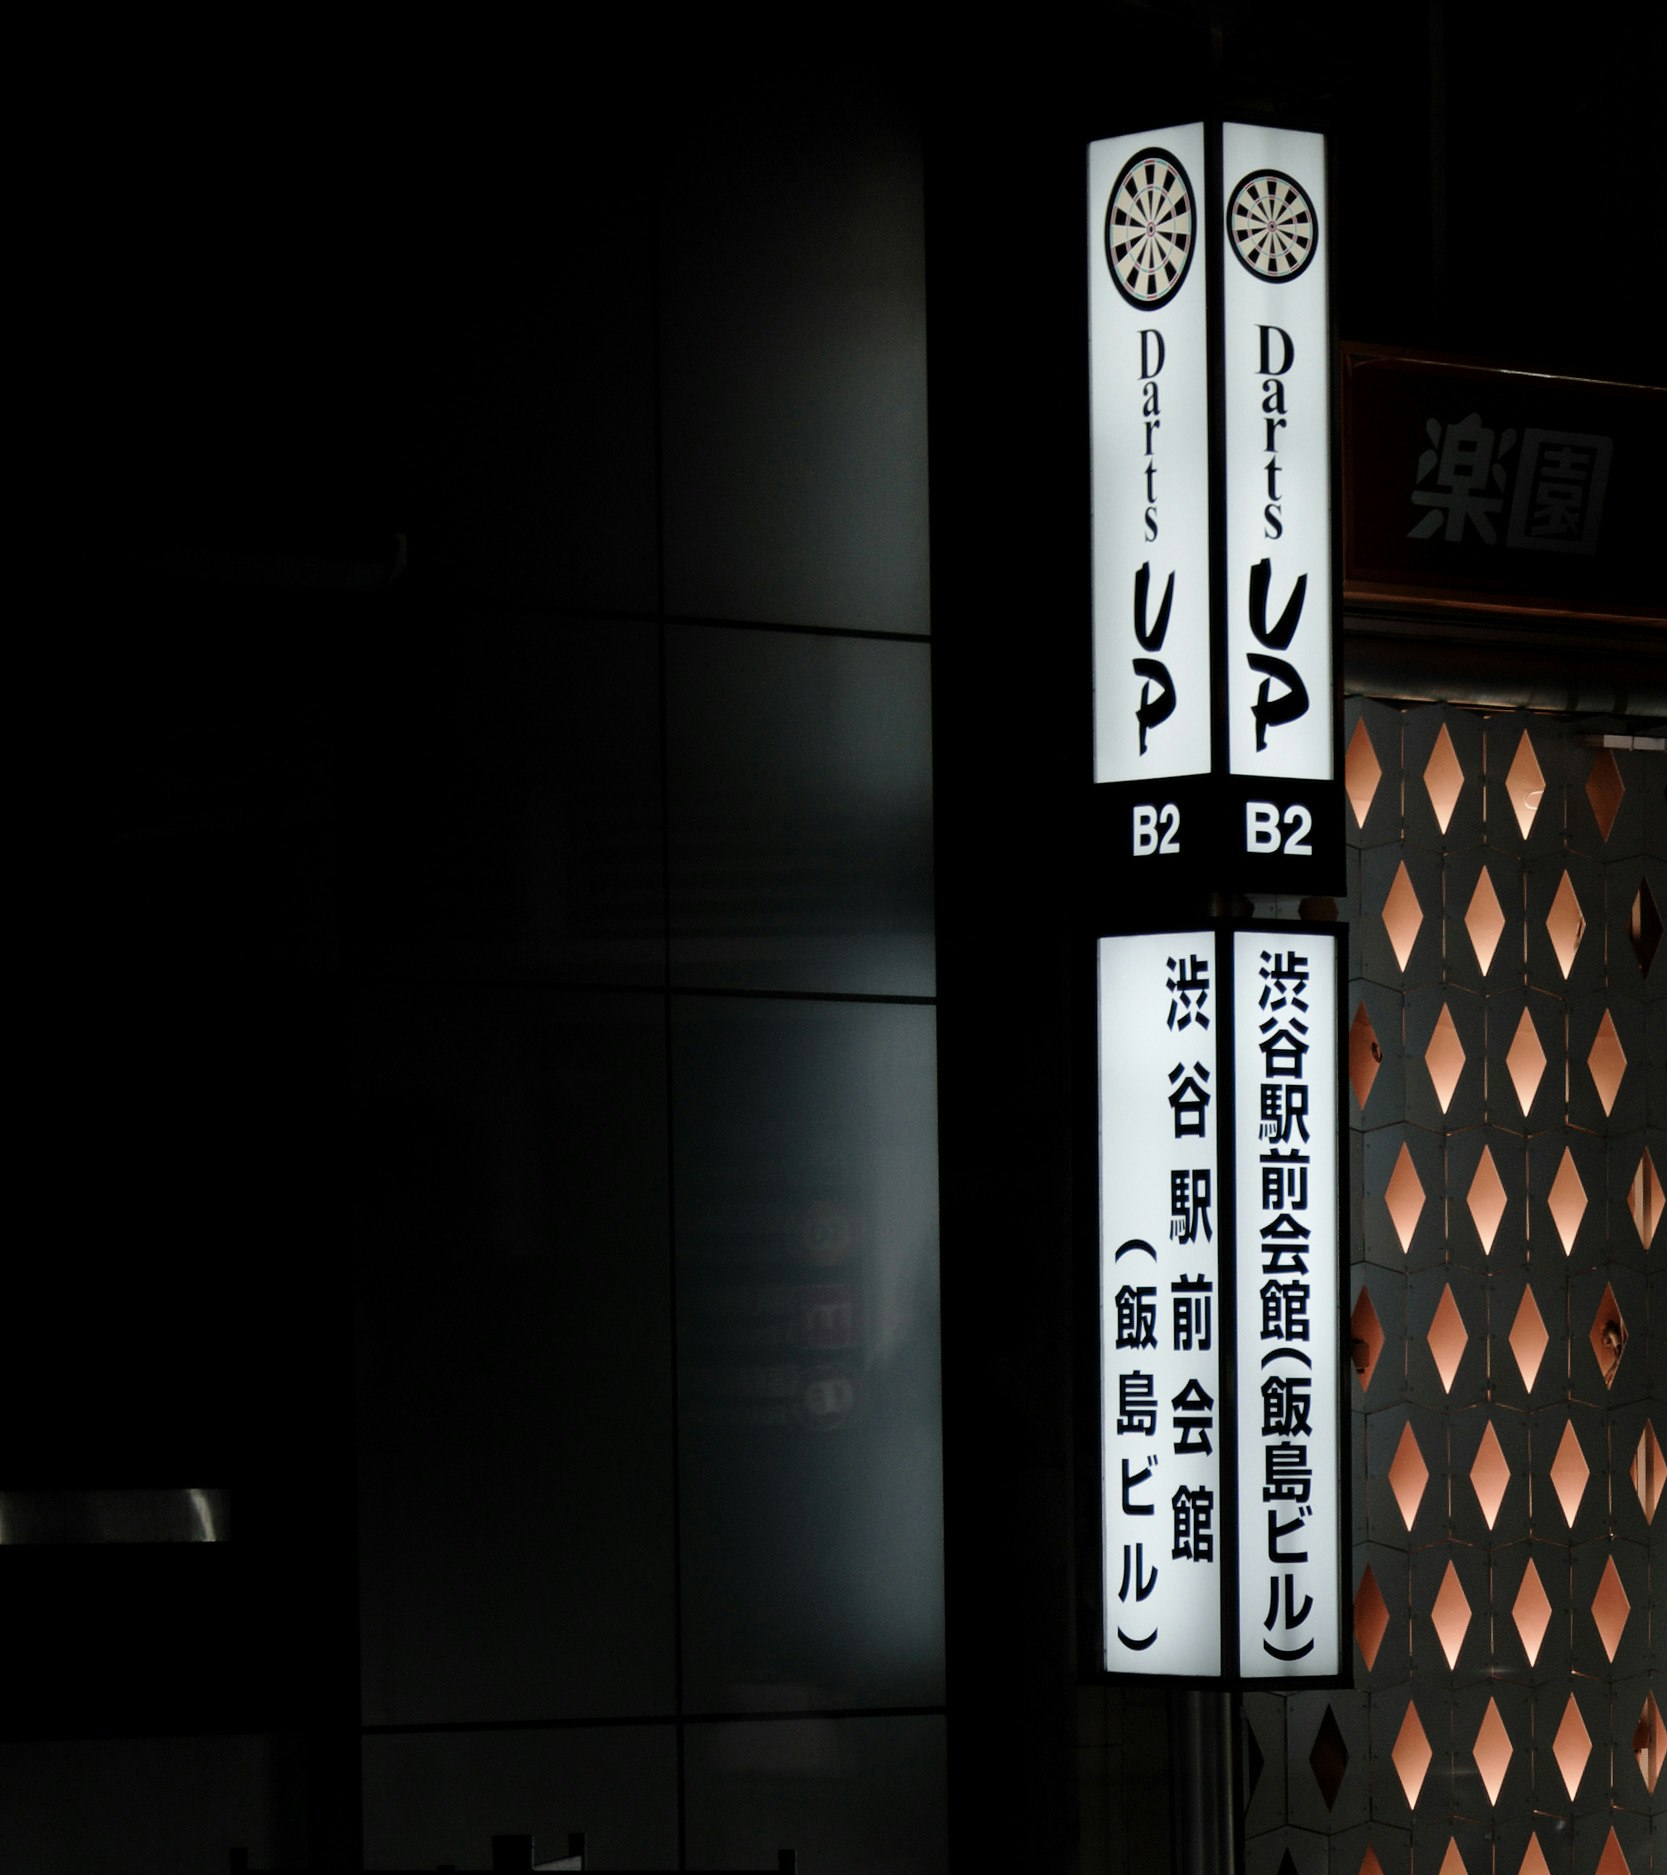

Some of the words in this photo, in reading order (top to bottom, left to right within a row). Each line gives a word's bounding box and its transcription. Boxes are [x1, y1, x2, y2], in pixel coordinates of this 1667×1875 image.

[1138, 328, 1165, 543] Darts
[1253, 324, 1295, 541] Darts
[1406, 410, 1615, 559] 楽園
[1132, 559, 1177, 756] UP
[1246, 557, 1310, 753] UP
[1131, 803, 1182, 857] B2
[1244, 801, 1314, 857] B2
[1165, 953, 1214, 1563] 渋谷駅前会館
[1257, 950, 1315, 1662] 渋谷駅前会館（飯島ビル）
[1114, 1239, 1159, 1652] （飯島ビル）
